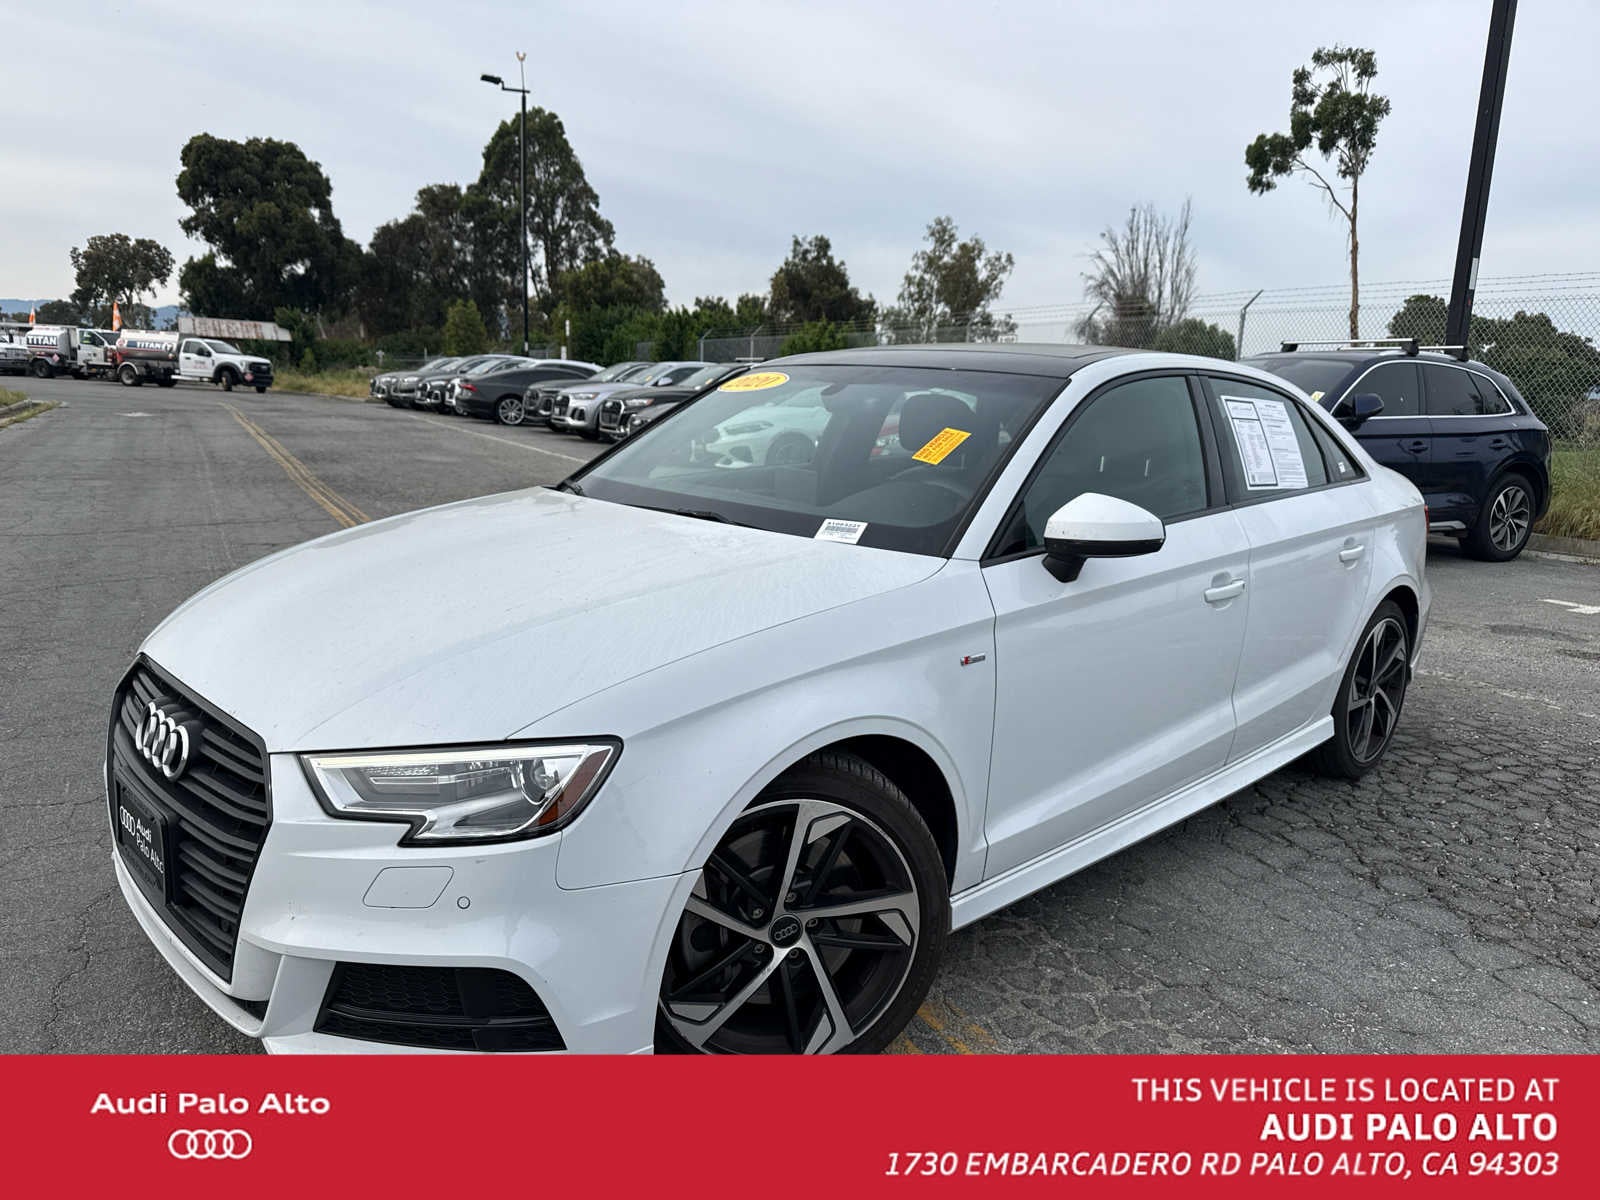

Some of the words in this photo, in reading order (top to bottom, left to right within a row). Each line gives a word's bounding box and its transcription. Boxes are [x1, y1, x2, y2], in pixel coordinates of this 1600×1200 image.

[27, 336, 57, 346] TITAN
[136, 341, 160, 350] TITAN
[136, 818, 152, 843] Audi
[136, 832, 150, 858] Palo
[150, 848, 165, 874] Alto
